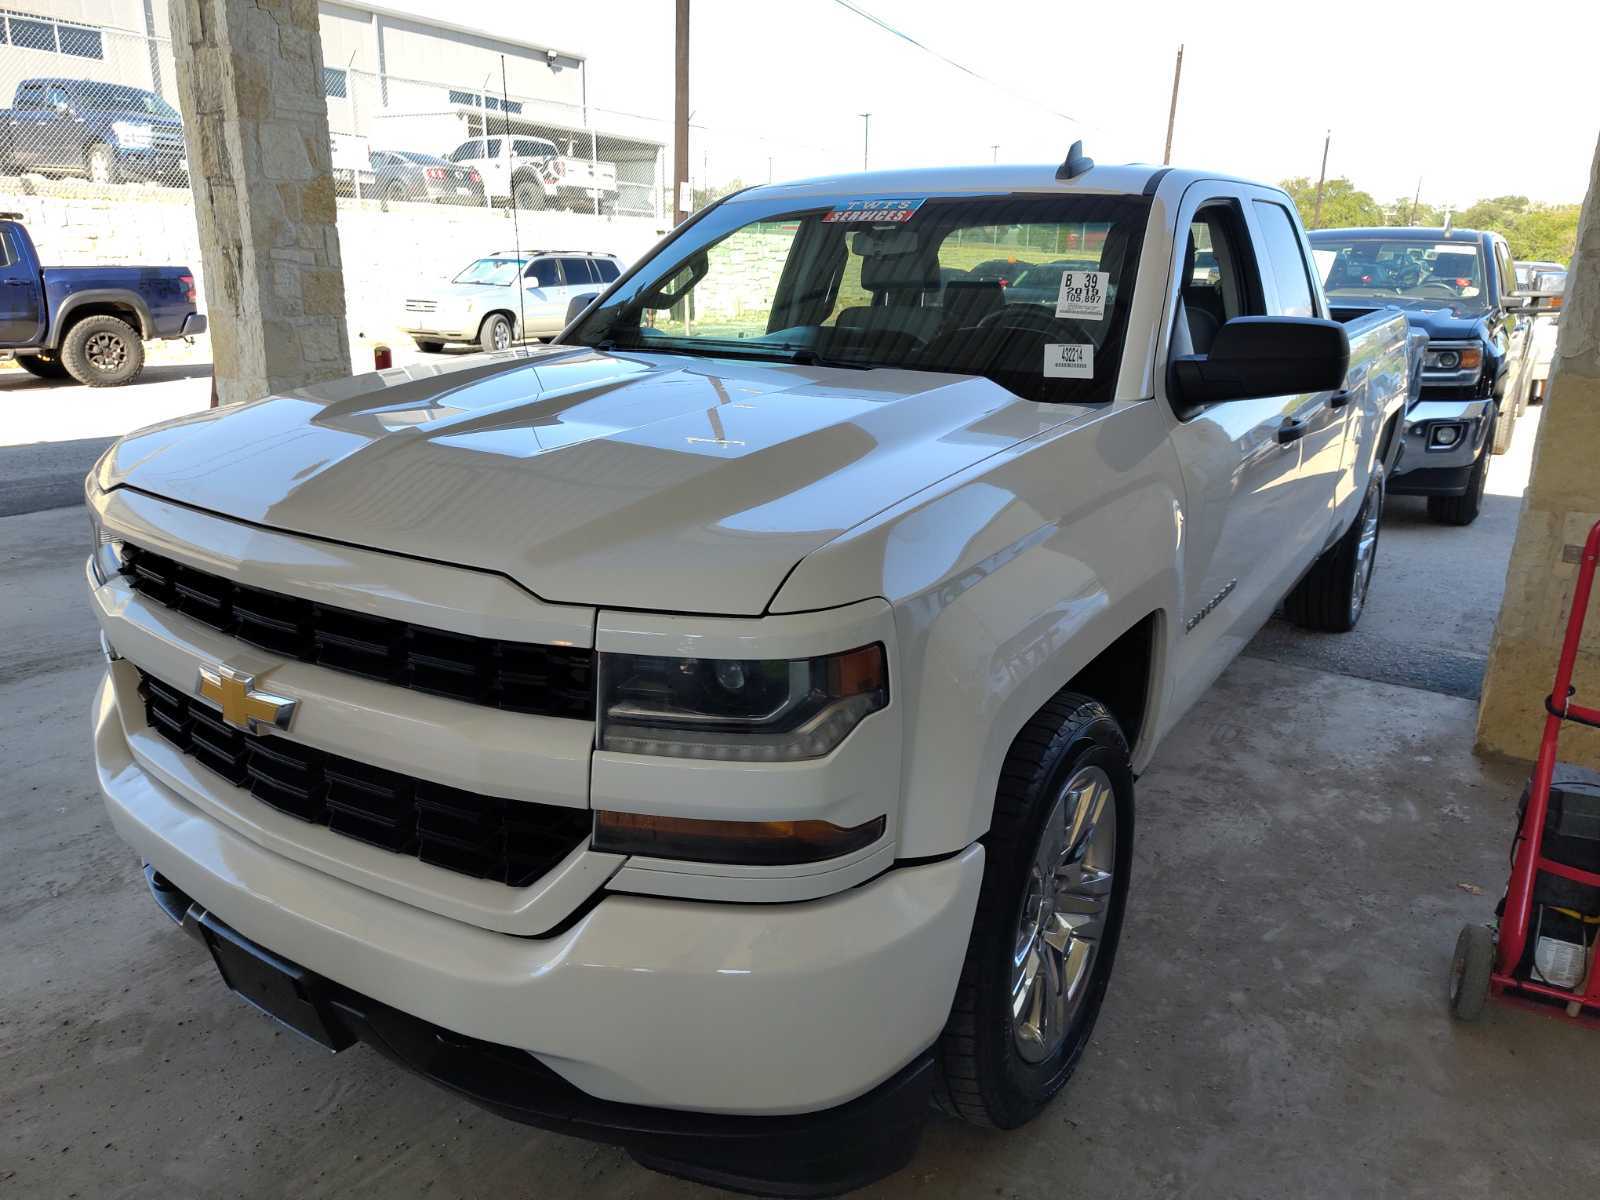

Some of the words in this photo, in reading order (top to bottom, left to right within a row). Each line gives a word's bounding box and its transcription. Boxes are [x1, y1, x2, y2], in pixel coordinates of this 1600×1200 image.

[830, 210, 905, 222] SERVICES
[1065, 273, 1073, 287] B
[1084, 273, 1098, 288] 39
